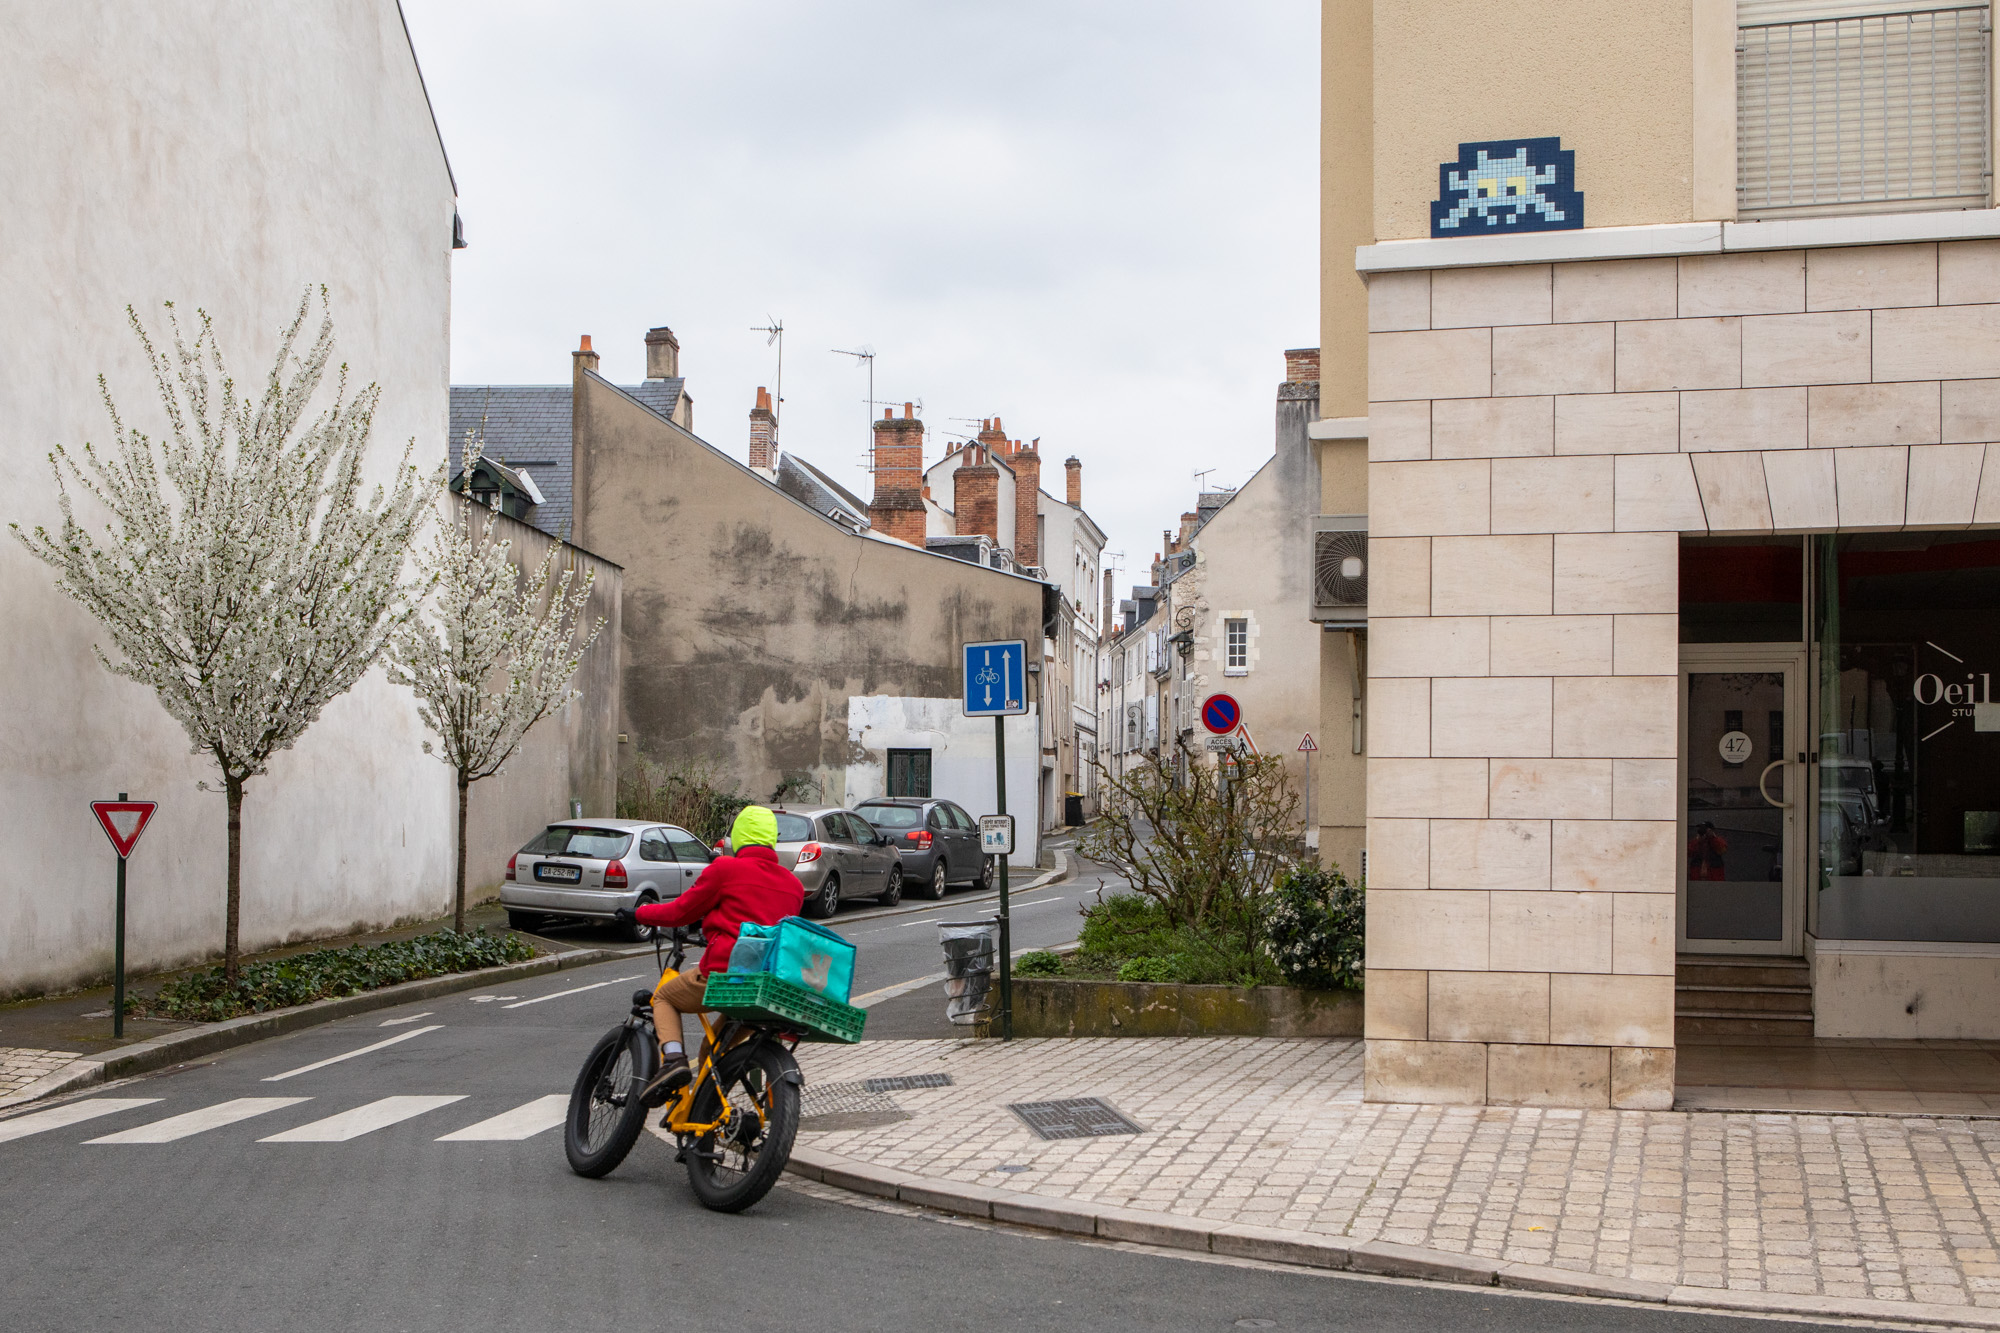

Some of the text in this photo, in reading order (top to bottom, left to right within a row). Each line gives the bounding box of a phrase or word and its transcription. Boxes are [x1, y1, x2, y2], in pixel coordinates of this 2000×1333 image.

[1913, 673, 1990, 705] Oeil
[1952, 709, 1975, 717] STU
[1725, 738, 1745, 752] 47
